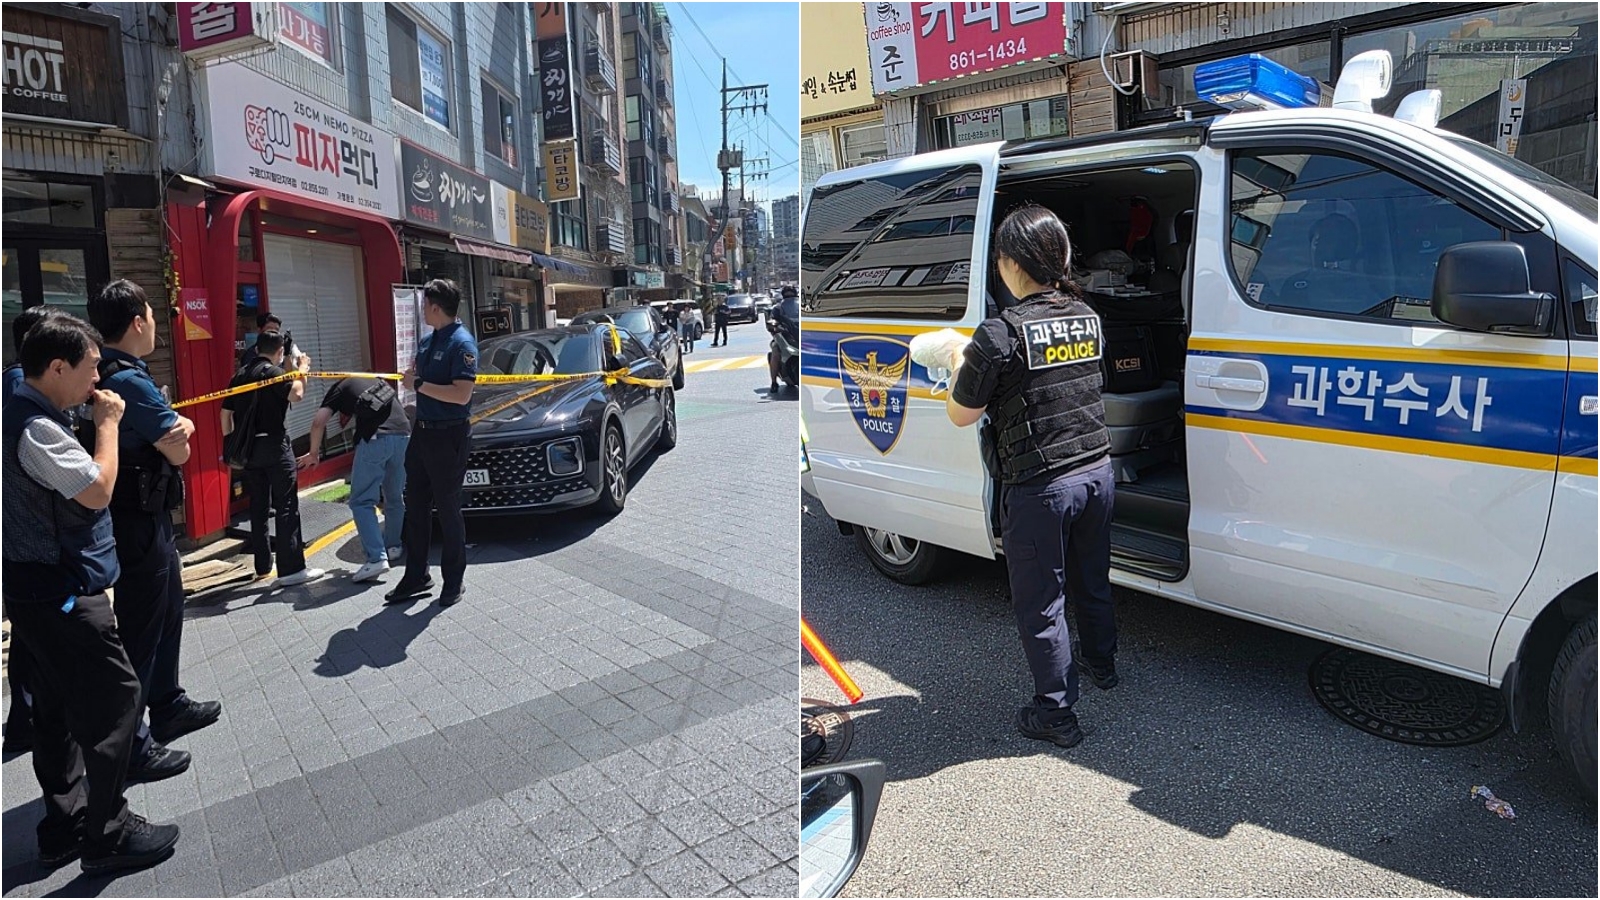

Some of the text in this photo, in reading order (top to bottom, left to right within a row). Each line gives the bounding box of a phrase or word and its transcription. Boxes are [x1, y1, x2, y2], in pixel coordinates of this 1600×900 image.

[870, 20, 911, 41] coffee shop
[2, 44, 65, 92] HOT
[880, 45, 904, 82] 준
[949, 37, 1027, 71] 861-1434
[12, 87, 68, 103] COFFEE
[828, 68, 857, 94] 속눈썹
[293, 101, 374, 145] 25CM NEMO PIZZA
[293, 122, 379, 190] 피자먹다
[553, 154, 571, 192] 타코방
[520, 205, 546, 244] 타코방
[186, 300, 208, 311] NSOK
[1030, 318, 1098, 346] 과학수사
[1046, 341, 1095, 364] POLICE
[1115, 357, 1141, 370] KCSI
[851, 391, 901, 414] 경 찰
[1287, 365, 1492, 433] 과학수사
[862, 418, 895, 434] POLICE
